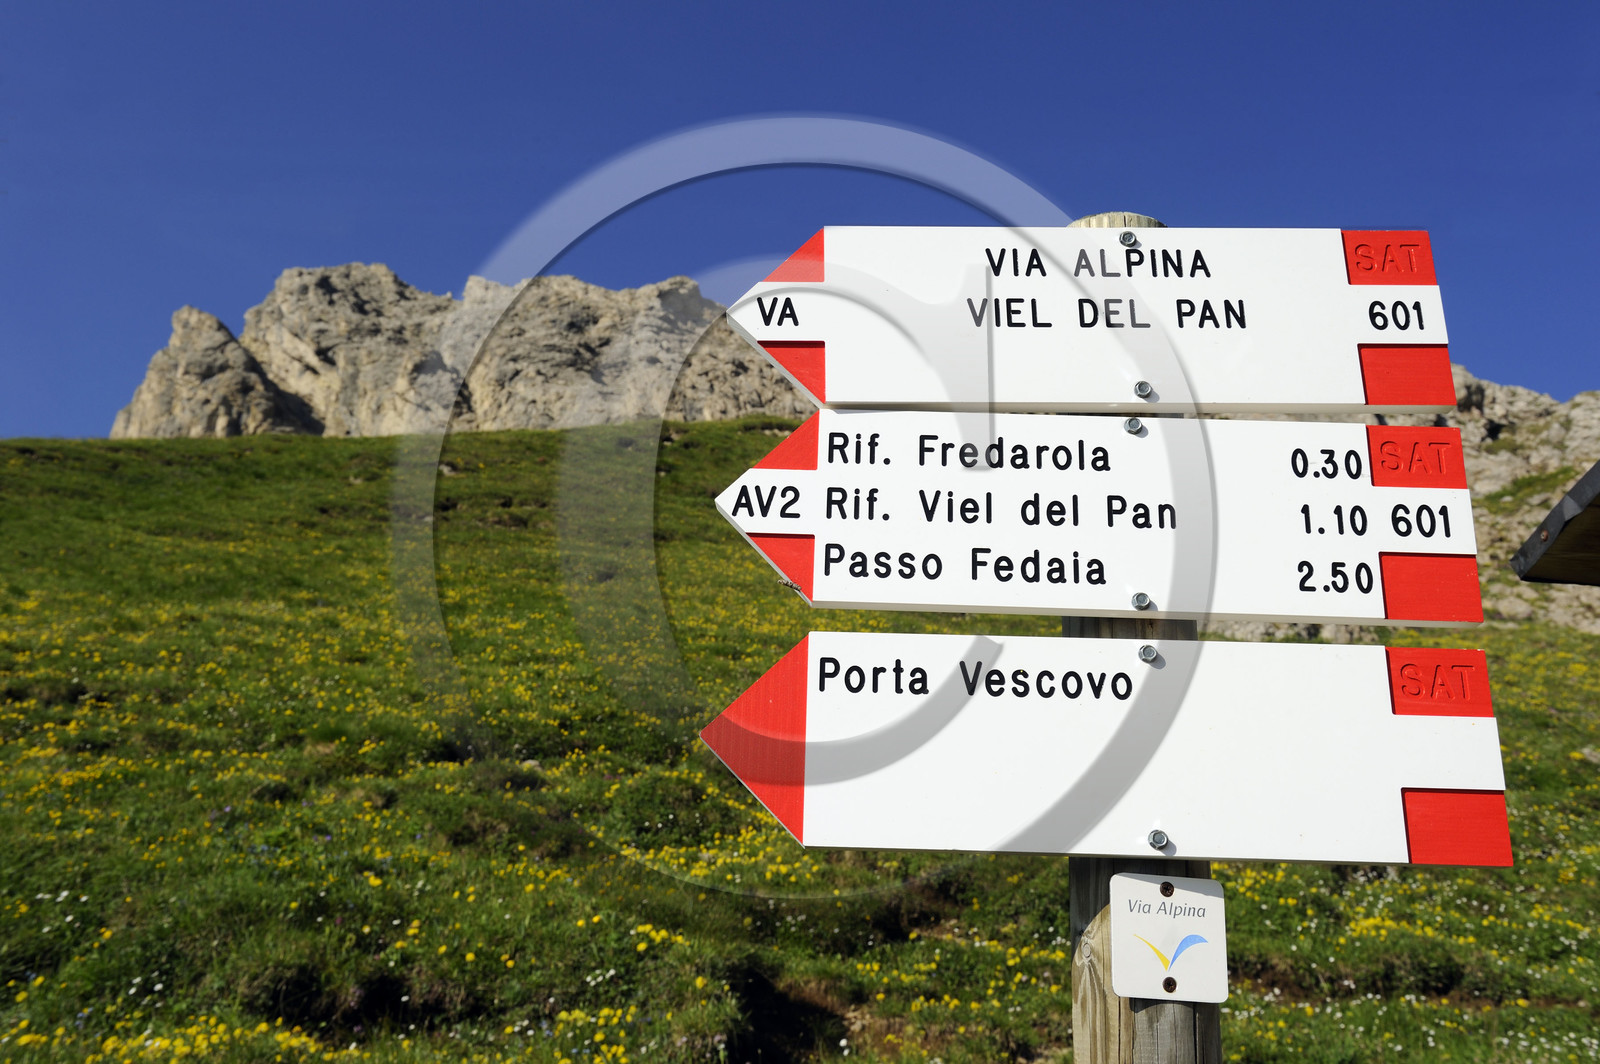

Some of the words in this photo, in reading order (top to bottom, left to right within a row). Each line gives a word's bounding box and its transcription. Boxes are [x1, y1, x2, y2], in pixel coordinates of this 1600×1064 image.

[985, 248, 1046, 276] VIA
[1074, 248, 1211, 278] ALPINA
[1354, 243, 1424, 273] SAT
[757, 297, 798, 326] VA
[967, 298, 1052, 327] VIEL
[1078, 299, 1151, 328] DEL
[1177, 300, 1246, 328] PAN
[1369, 301, 1424, 330] 601
[828, 433, 890, 464] Rif.
[920, 435, 1110, 470] Fredarola
[1292, 449, 1362, 479] 0.30
[1378, 442, 1452, 476] SAT
[732, 485, 800, 518] AV2
[827, 487, 889, 520] Rif.
[919, 490, 991, 523] Viel
[1021, 493, 1078, 526] del
[1107, 495, 1176, 529] Pan
[1301, 505, 1367, 536] 1.10
[1392, 504, 1450, 537] 601
[825, 544, 942, 579] Passo
[972, 548, 1106, 584] Fedaia
[1298, 561, 1373, 593] 2.50
[819, 657, 929, 694] Porta
[960, 661, 1132, 700] Vescovo
[1400, 663, 1475, 701] SAT
[1128, 899, 1152, 914] Via
[1157, 901, 1207, 919] Alpina
